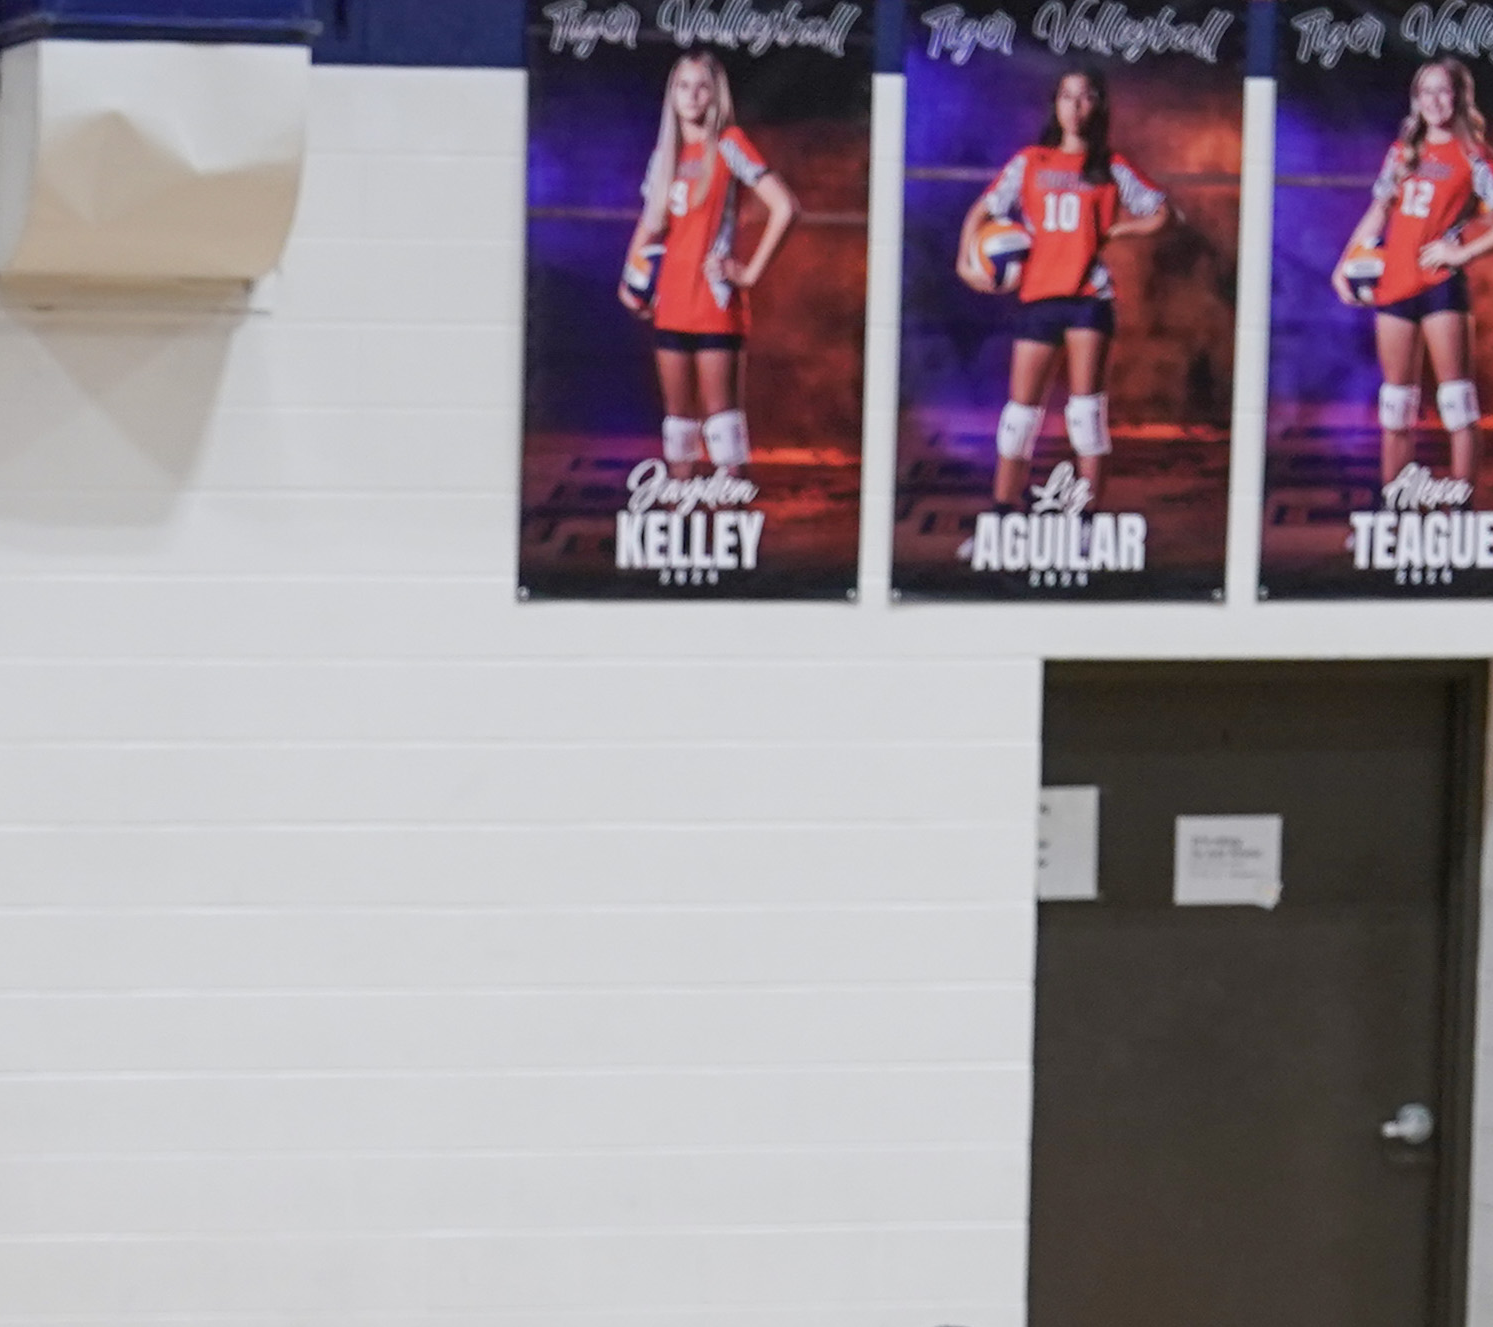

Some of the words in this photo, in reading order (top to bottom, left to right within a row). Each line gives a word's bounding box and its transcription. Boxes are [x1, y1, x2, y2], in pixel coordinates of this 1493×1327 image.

[1032, 0, 1235, 63] Volleyball
[1043, 191, 1081, 232] 10
[1400, 176, 1435, 218] 12
[615, 509, 765, 571] KELLEY
[970, 511, 1148, 572] AGUILAR
